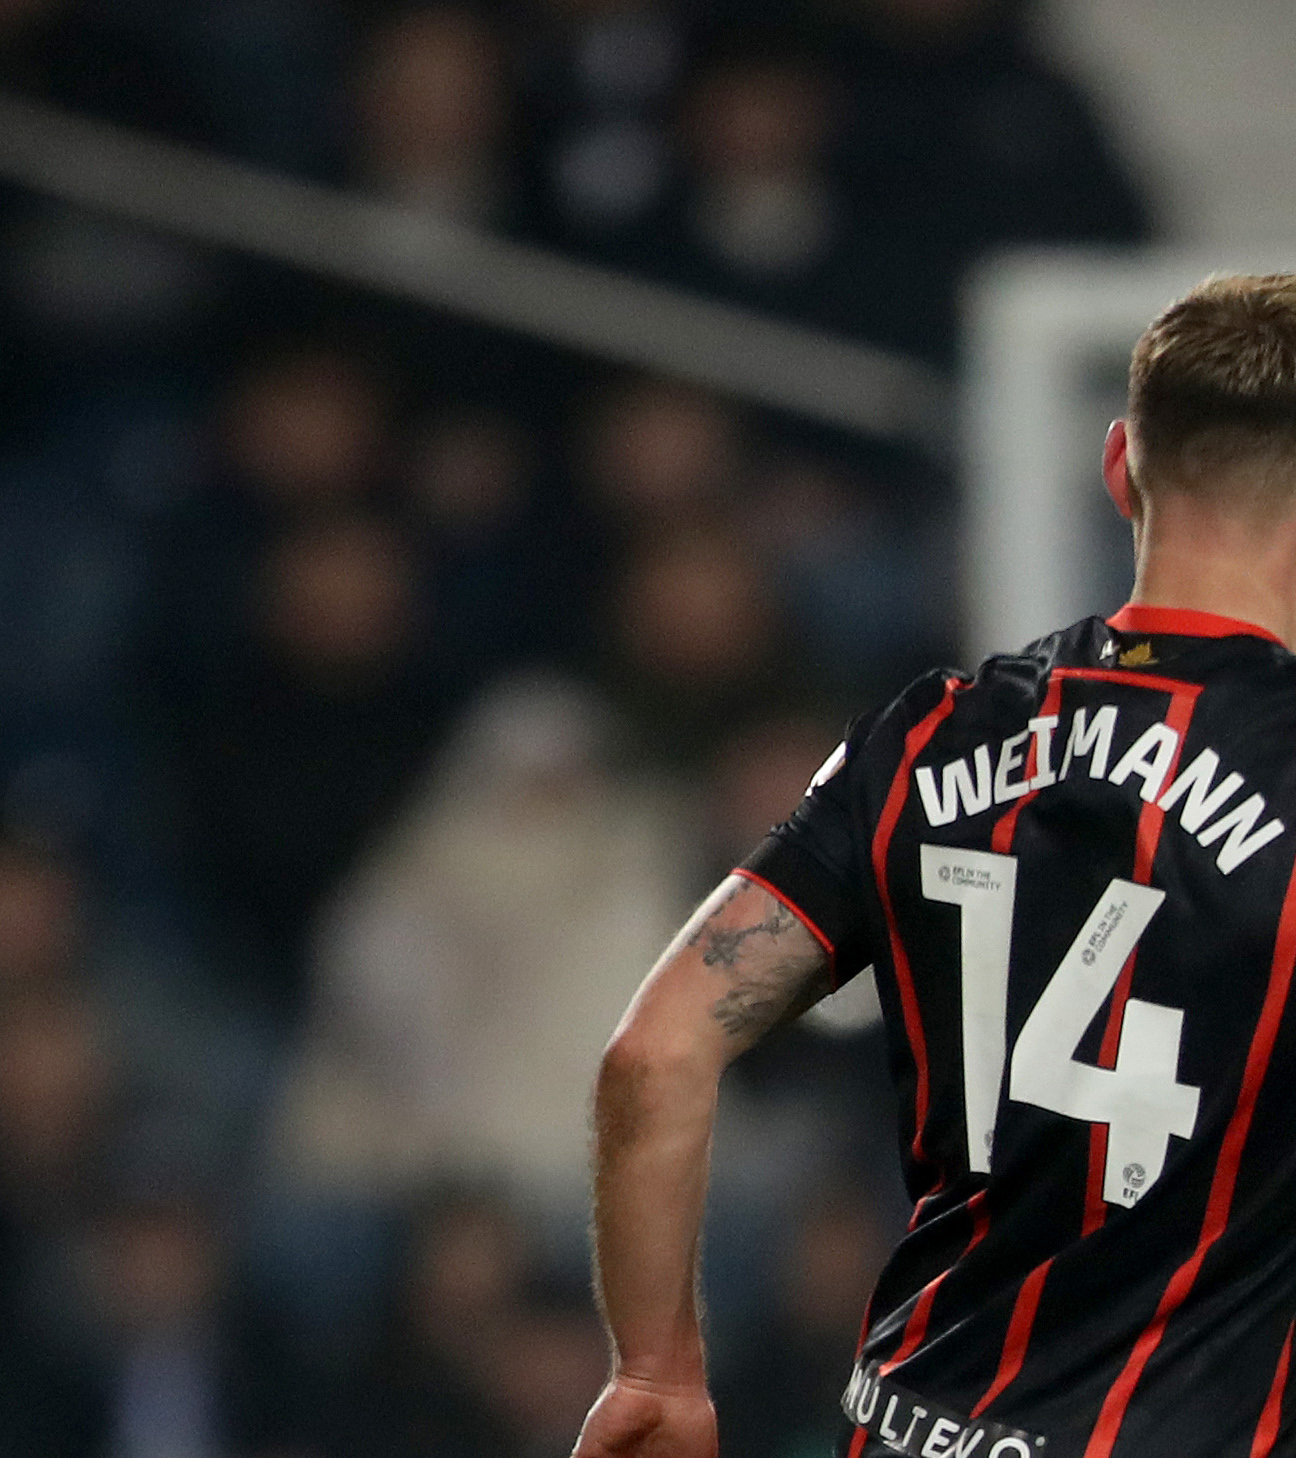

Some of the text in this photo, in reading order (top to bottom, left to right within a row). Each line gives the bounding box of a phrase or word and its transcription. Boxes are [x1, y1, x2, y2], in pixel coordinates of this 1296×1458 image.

[915, 704, 1285, 876] WEIMANN
[952, 877, 1001, 891] COMMUNITY
[1098, 901, 1128, 953] COMMUNITY
[920, 843, 1201, 1209] 14
